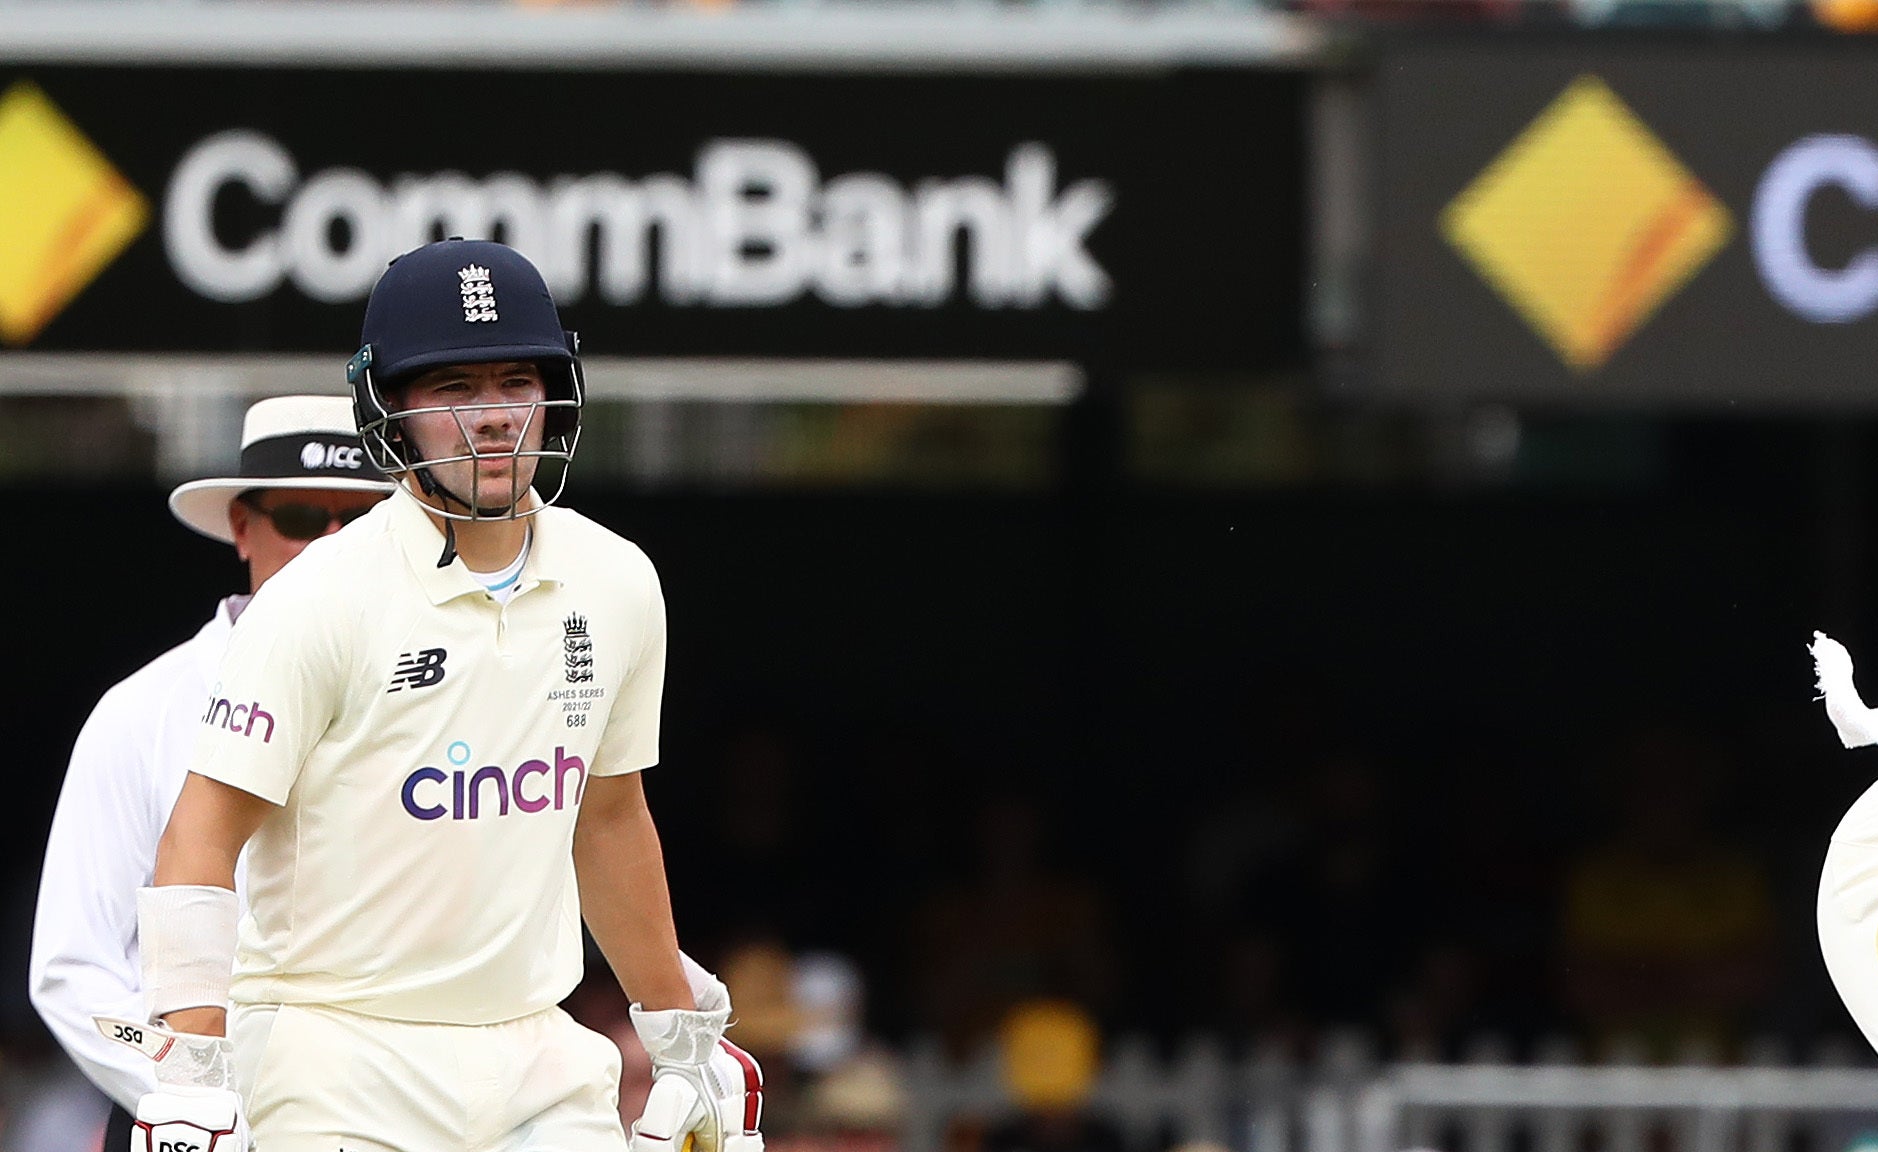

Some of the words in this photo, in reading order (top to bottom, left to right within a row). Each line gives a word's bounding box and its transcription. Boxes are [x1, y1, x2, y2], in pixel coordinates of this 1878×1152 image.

[325, 444, 364, 469] ICC
[547, 689, 576, 700] ASHES
[201, 681, 275, 743] inch
[566, 714, 587, 728] 688
[401, 740, 586, 821] cinch
[114, 1024, 143, 1045] DSC
